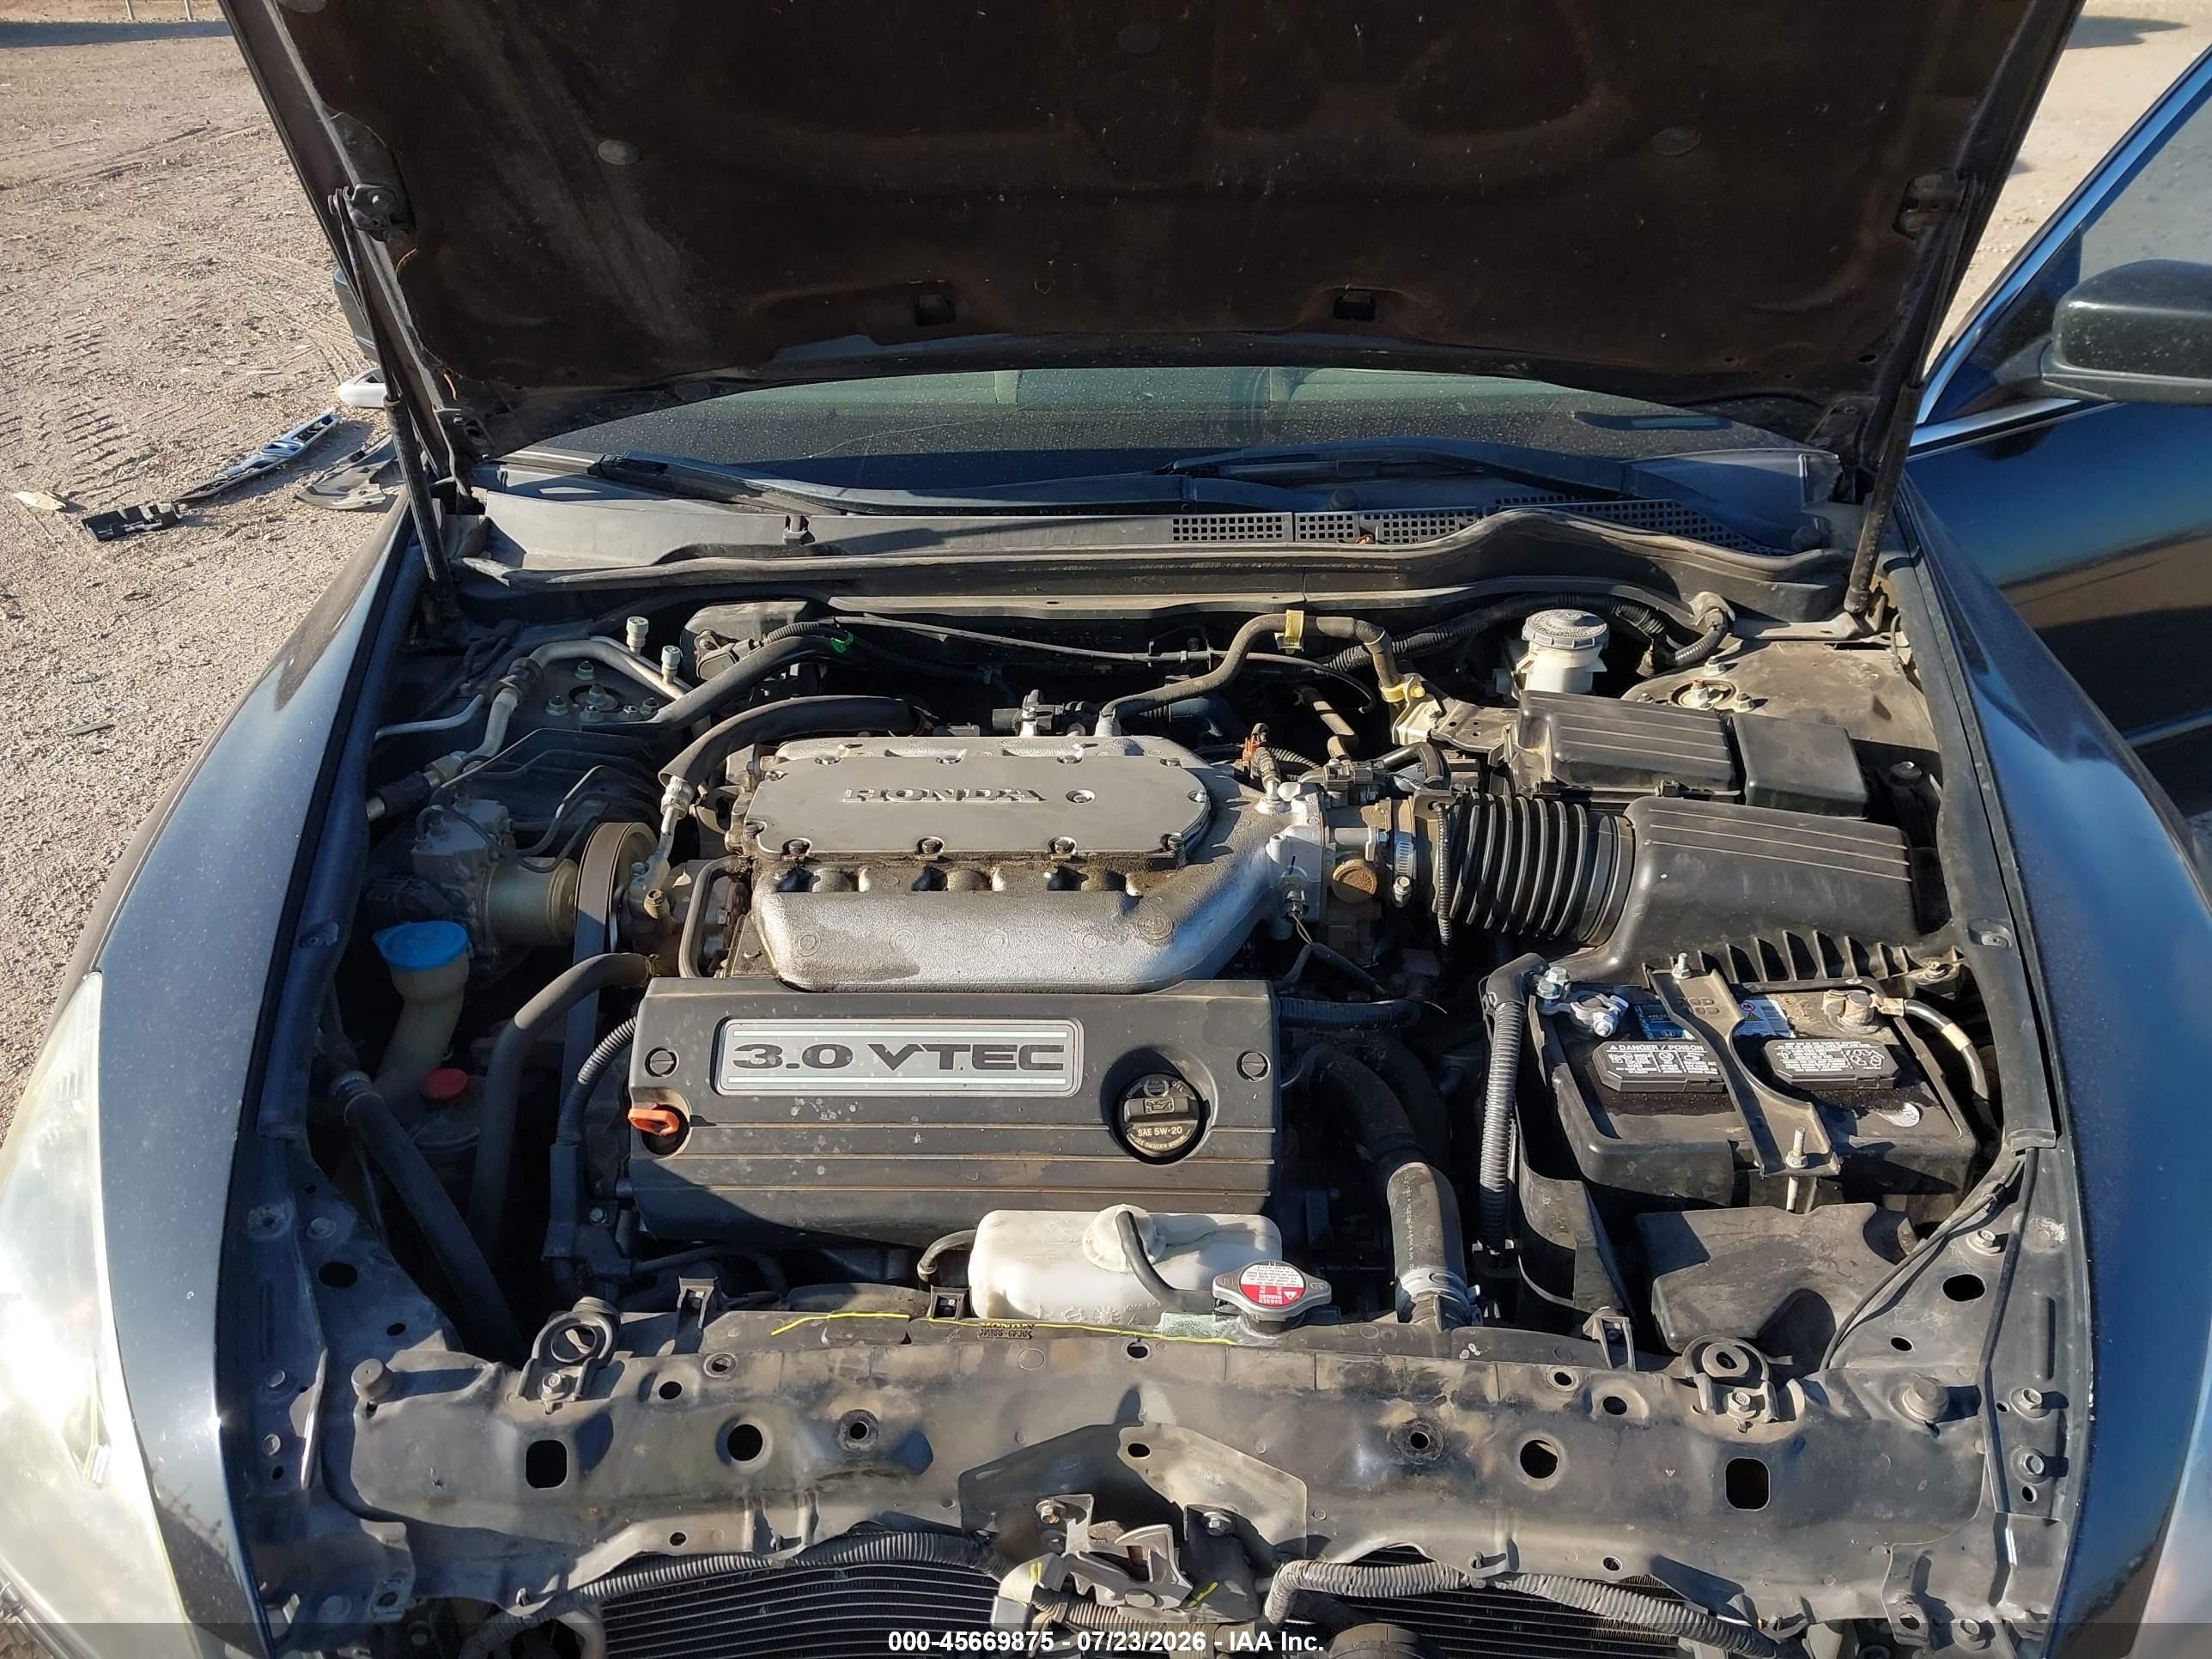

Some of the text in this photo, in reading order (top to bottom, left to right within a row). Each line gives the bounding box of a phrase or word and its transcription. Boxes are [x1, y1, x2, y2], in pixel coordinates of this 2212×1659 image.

[842, 788, 1047, 803] HONDA
[732, 1043, 1065, 1072] 3.0 VTEC
[1172, 1081, 1184, 1093] OIL
[1154, 1126, 1182, 1136] 5W-20
